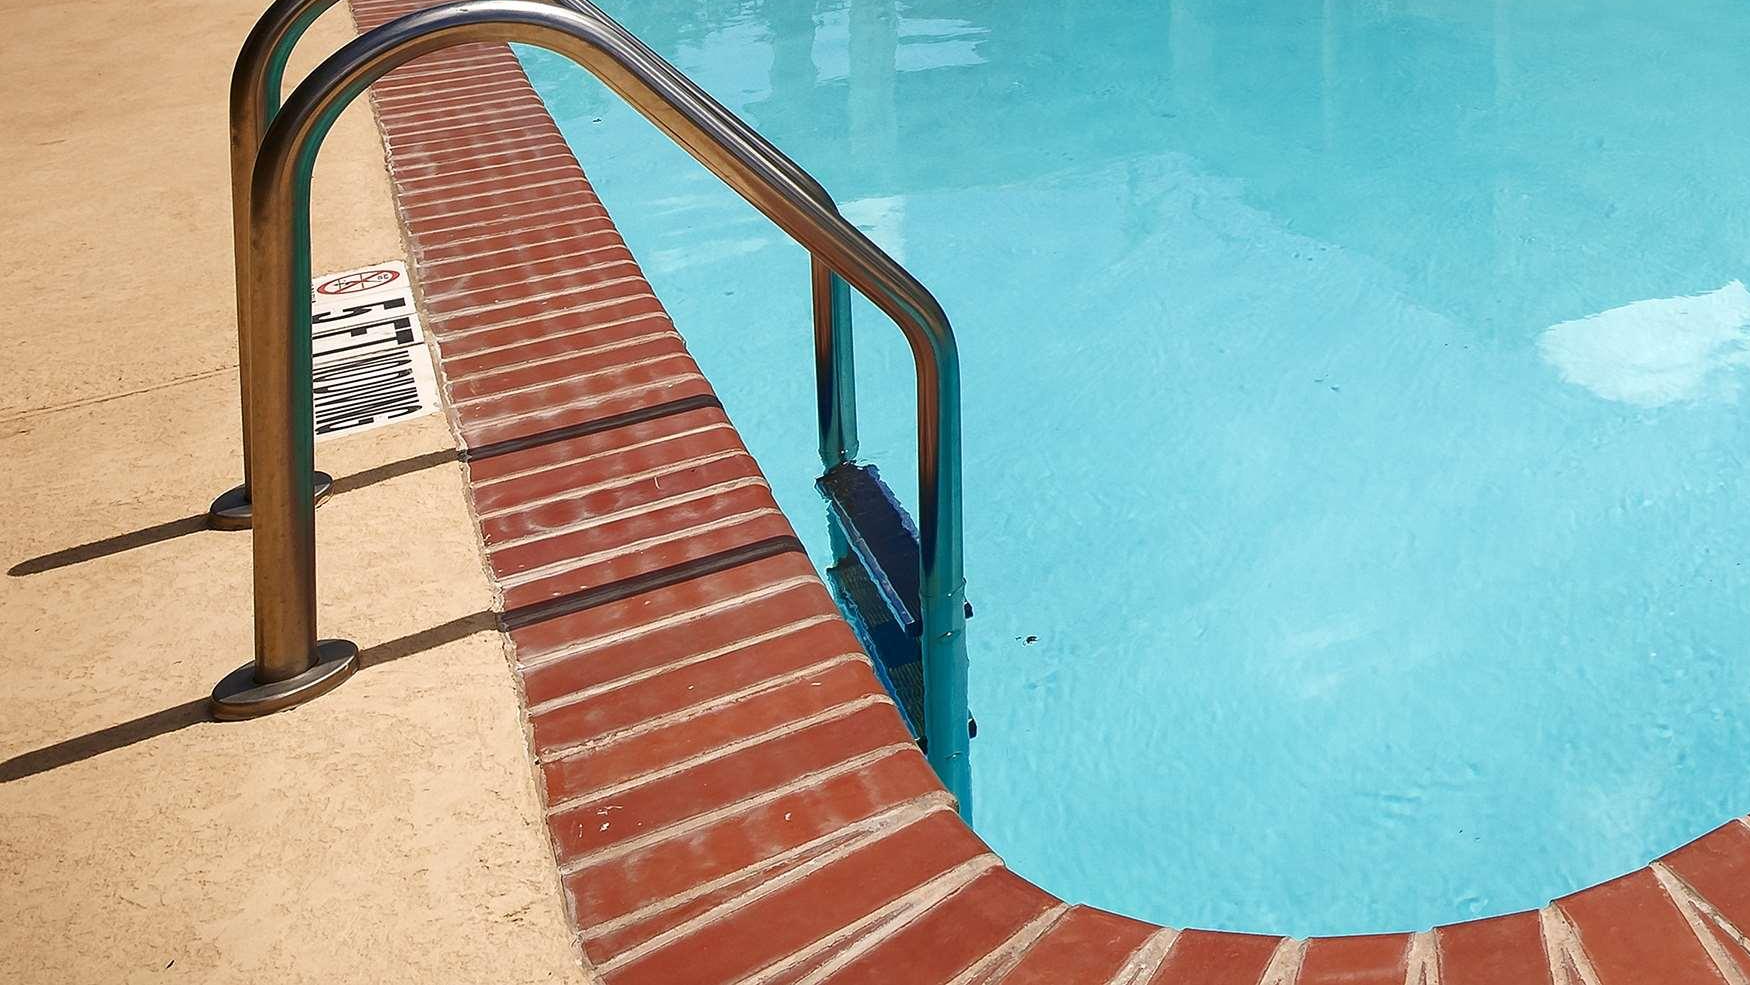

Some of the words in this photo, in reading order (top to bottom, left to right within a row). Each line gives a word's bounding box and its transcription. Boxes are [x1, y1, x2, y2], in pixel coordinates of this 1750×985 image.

[312, 297, 407, 324] 5
[312, 317, 415, 358] FT
[312, 350, 412, 382] NO
[313, 368, 423, 435] DIVING
